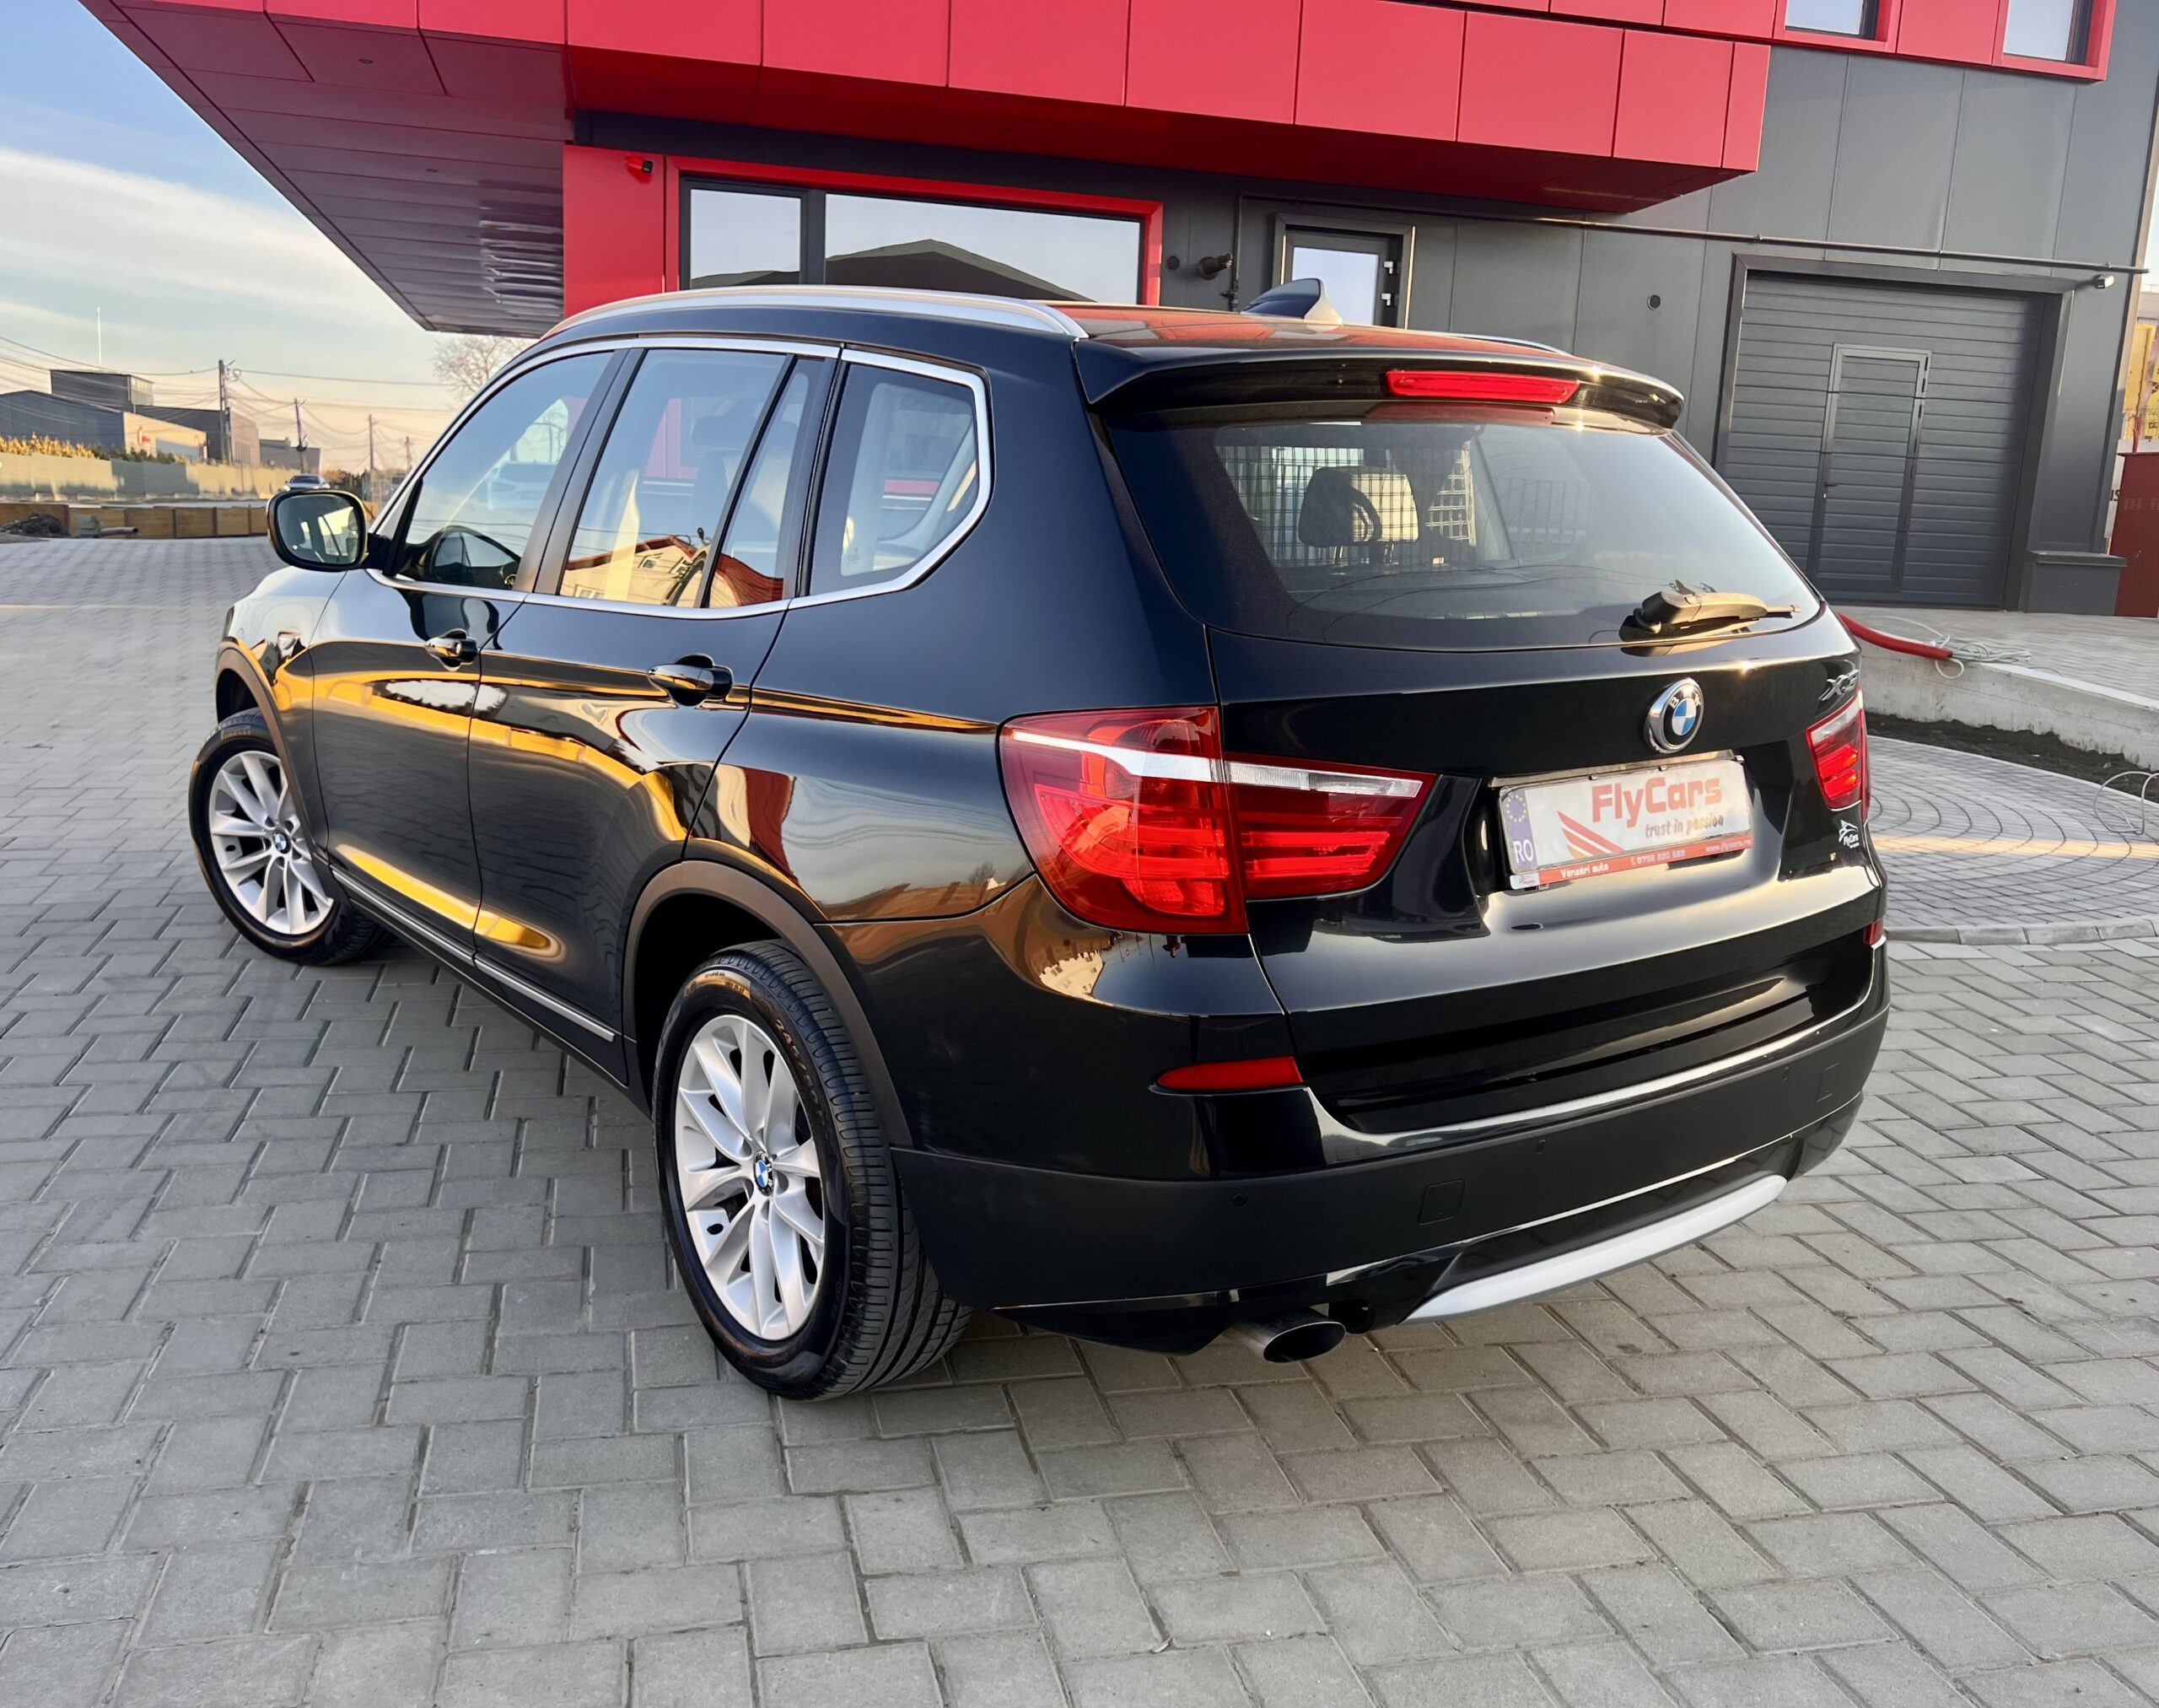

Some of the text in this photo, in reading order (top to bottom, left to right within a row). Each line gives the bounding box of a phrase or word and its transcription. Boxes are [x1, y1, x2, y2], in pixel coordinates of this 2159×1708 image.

[1591, 777, 1722, 828] FlyCars
[1645, 811, 1725, 838] trust in passion
[1512, 838, 1534, 864] RO
